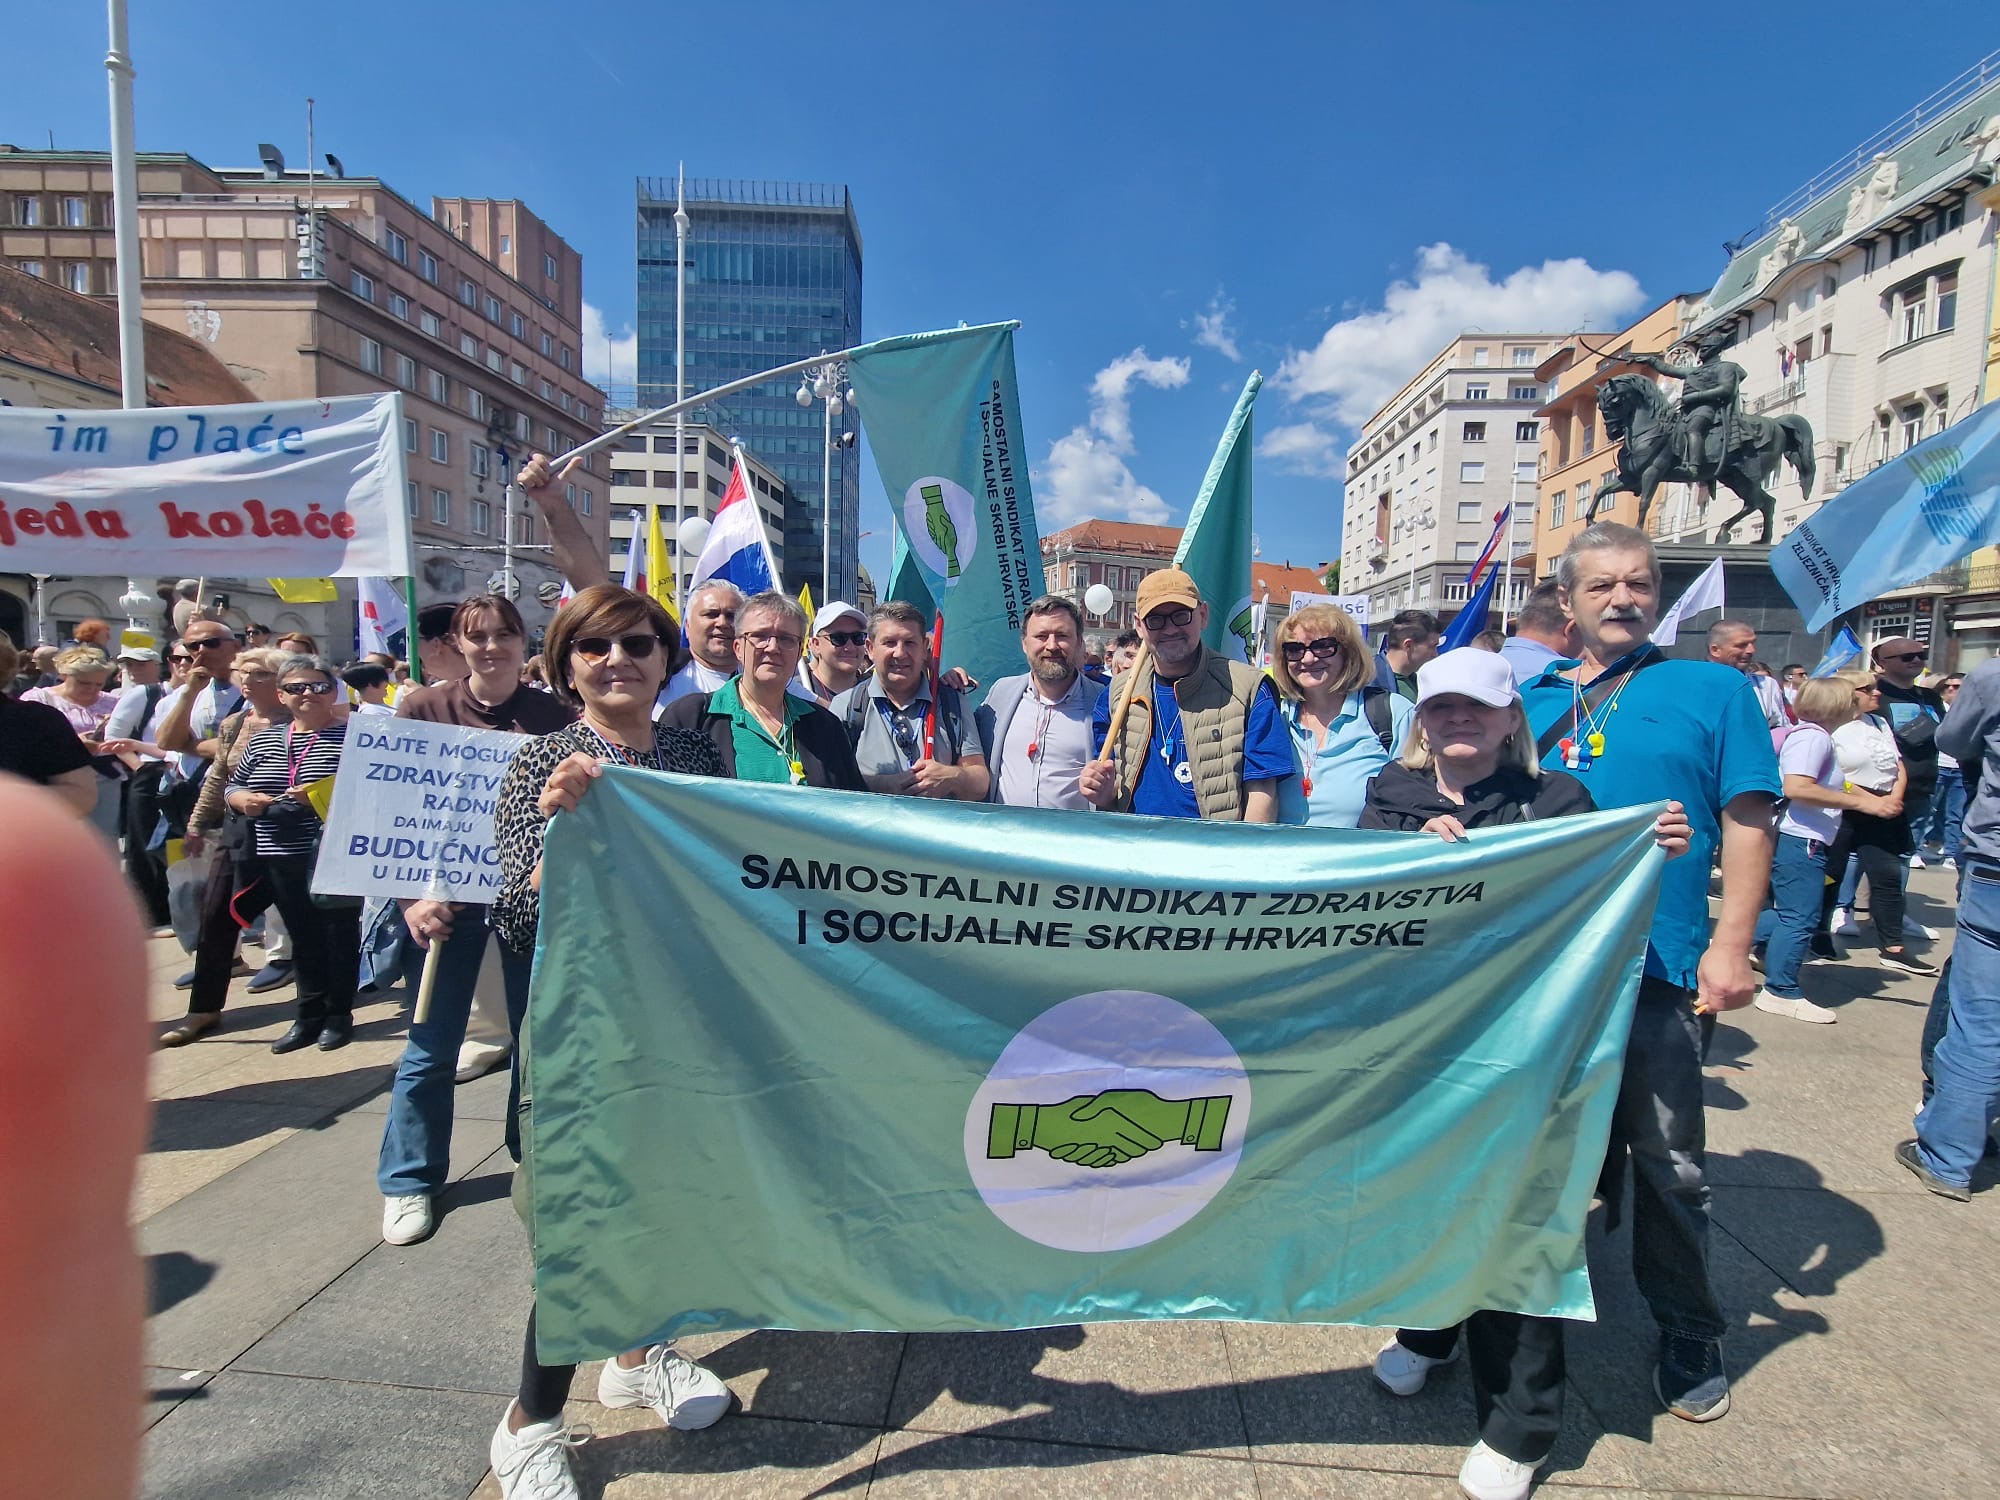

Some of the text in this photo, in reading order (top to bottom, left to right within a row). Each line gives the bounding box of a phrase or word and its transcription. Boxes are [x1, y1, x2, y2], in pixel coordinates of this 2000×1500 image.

[46, 413, 307, 461] im plaće
[981, 409, 999, 499] SOCIJALNE
[992, 379, 1034, 612] SAMOSTALNI SINDIKAT ZDRAV
[159, 498, 357, 539] kolače
[990, 503, 1007, 550] SKRBI
[1799, 522, 1828, 558] SINDIKAT
[998, 553, 1020, 631] HRVATSKE
[356, 732, 430, 755] DAJTE
[365, 762, 502, 792] ZDRAVSTV
[393, 815, 473, 833] DA IMAJU
[422, 793, 496, 816] RADNI
[349, 834, 500, 867] BUDUĆNO
[372, 864, 507, 888] U LIJEPOJ NA
[740, 853, 1486, 917] SAMOSTALNI SINDIKAT ZDRAVSTVA
[797, 909, 1429, 951] I SOCIJALNE SKRBI HRVATSKE
